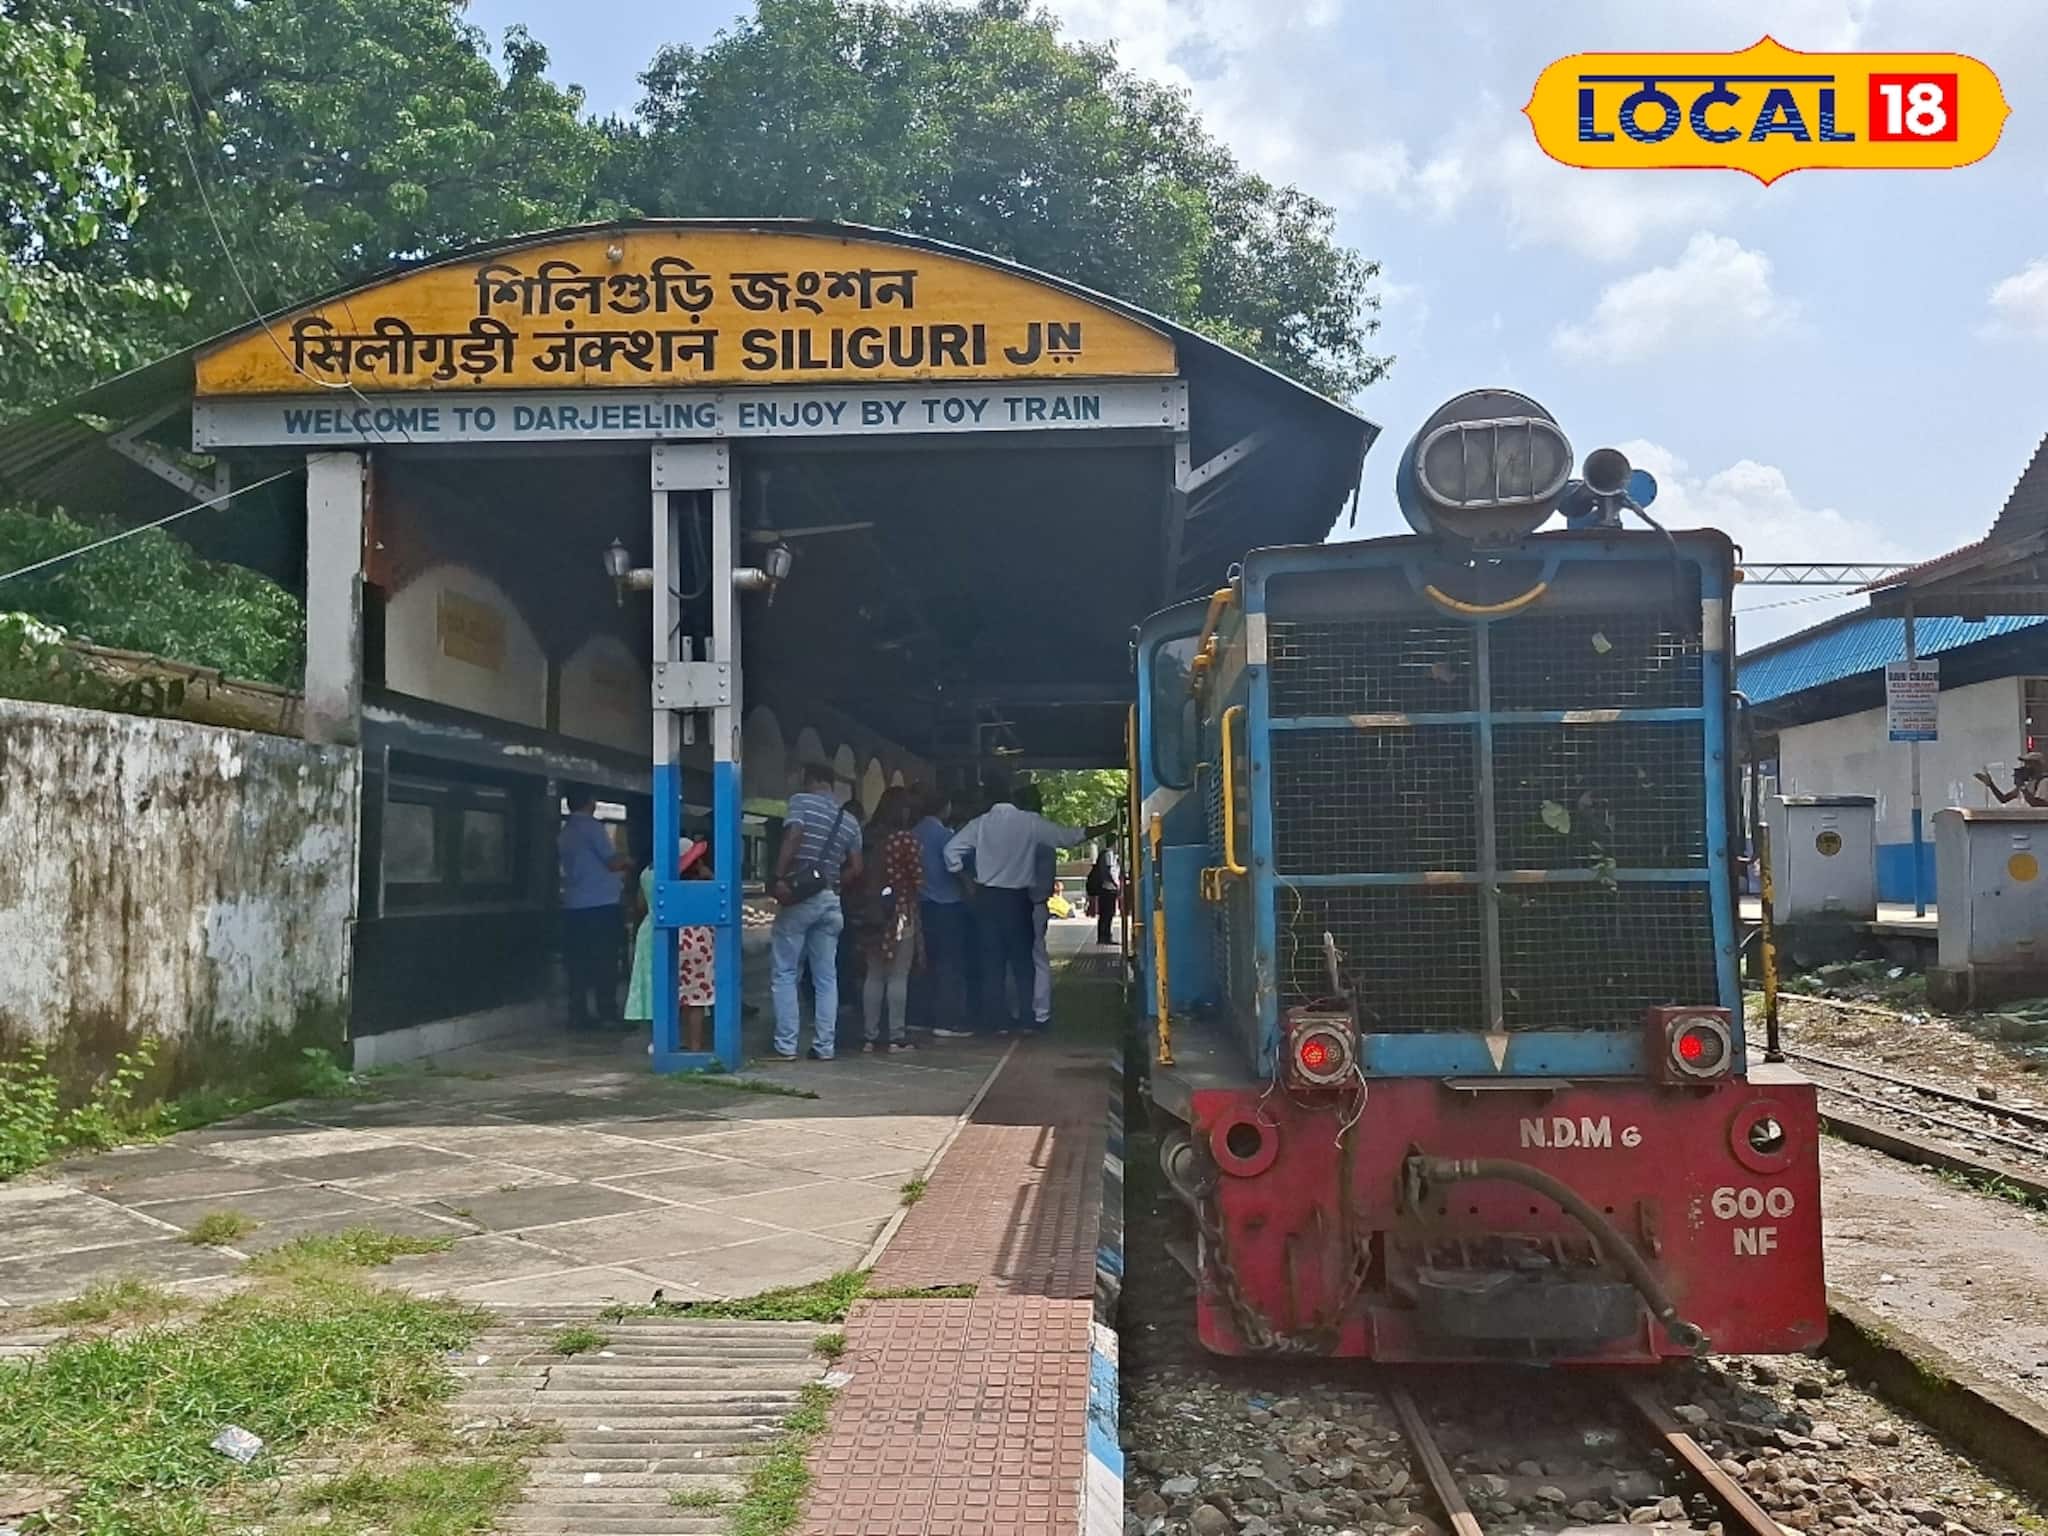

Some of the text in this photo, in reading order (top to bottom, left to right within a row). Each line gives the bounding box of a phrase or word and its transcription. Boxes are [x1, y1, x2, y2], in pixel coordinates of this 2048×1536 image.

[475, 256, 918, 323] শিলিগুড়ি জংশন
[290, 316, 719, 384] सिलीगुड़ी जंक्शन
[741, 324, 987, 371] SILIGURI
[284, 396, 1100, 434] WELCOME TO DARJEELING ENJOY BY TOY TRAIN
[1711, 1186, 1795, 1219] 600
[1733, 1227, 1778, 1255] NF
